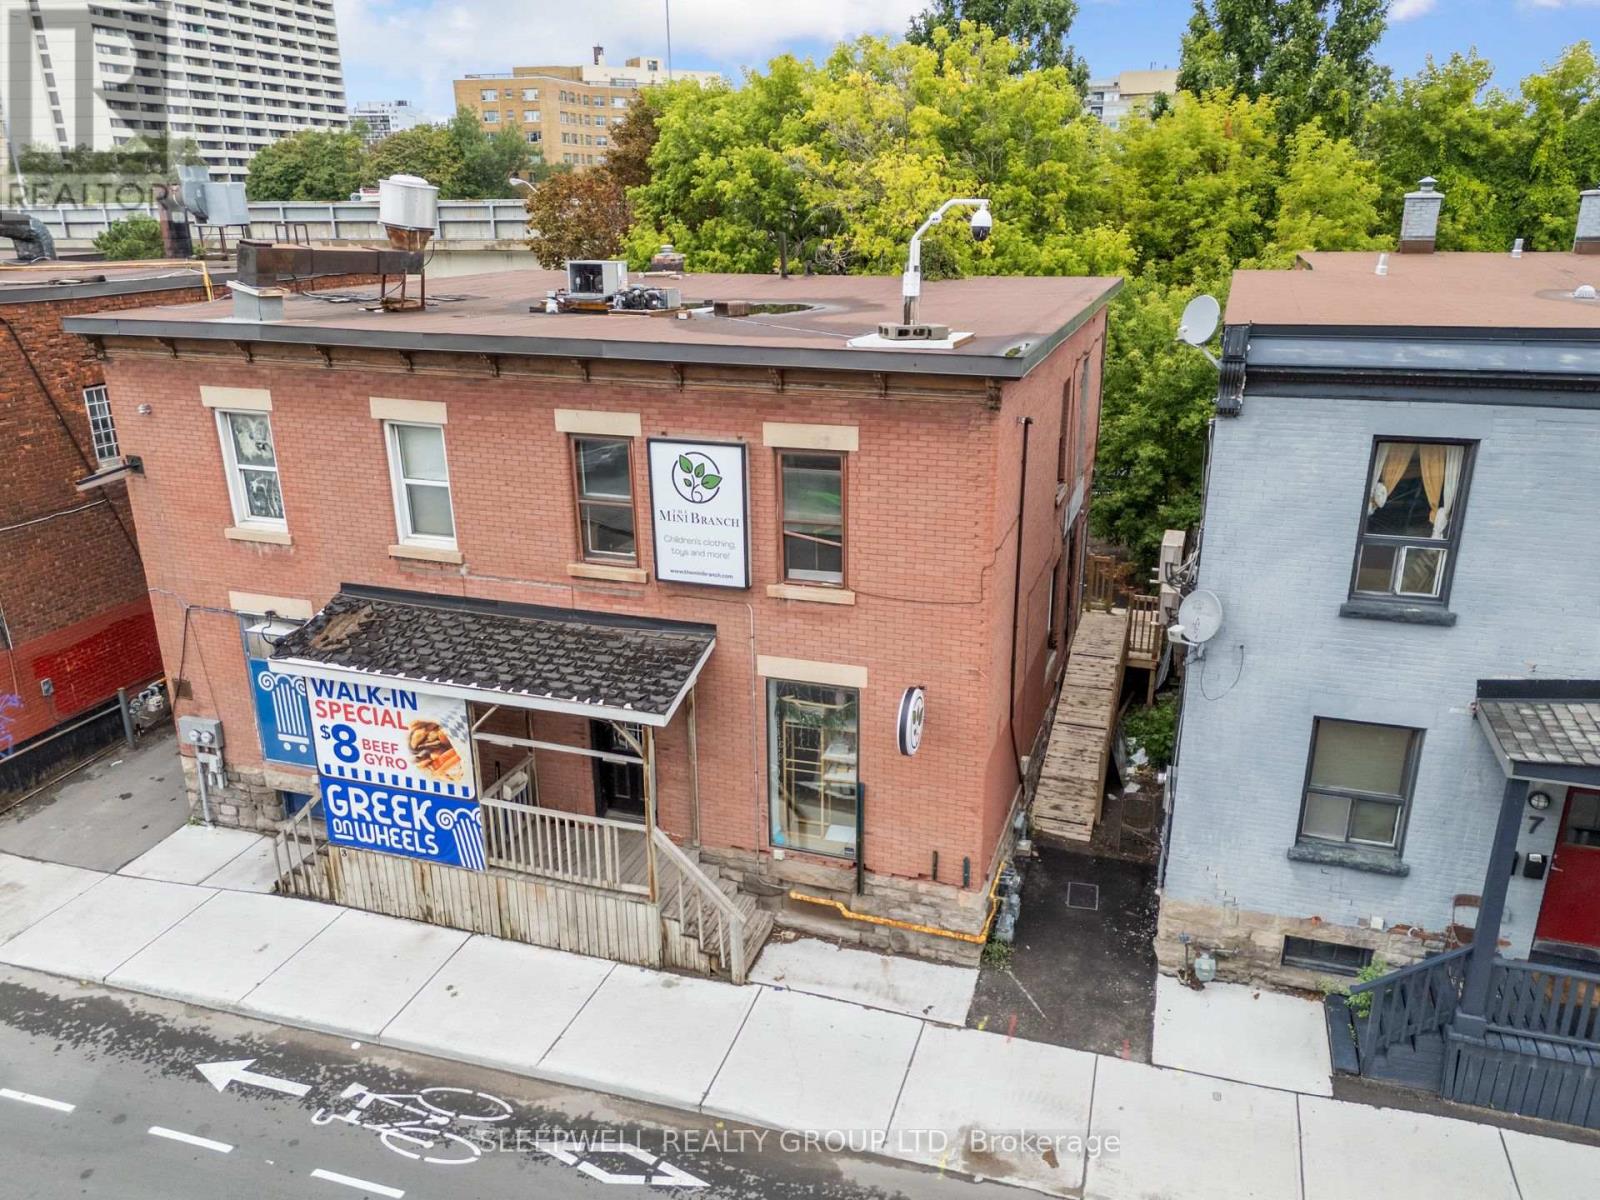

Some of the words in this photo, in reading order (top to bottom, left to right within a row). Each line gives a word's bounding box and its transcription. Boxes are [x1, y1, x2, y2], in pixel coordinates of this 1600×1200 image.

[691, 512, 740, 527] BRANCH
[671, 547, 689, 557] toys
[690, 549, 705, 557] and
[310, 677, 418, 711] WALK-IN
[315, 699, 410, 730] SPECIAL
[362, 738, 399, 754] BEEF
[364, 752, 408, 771] GYRO
[326, 784, 436, 833] GREEK
[1528, 815, 1545, 834] 7
[353, 820, 439, 856] WHEELS
